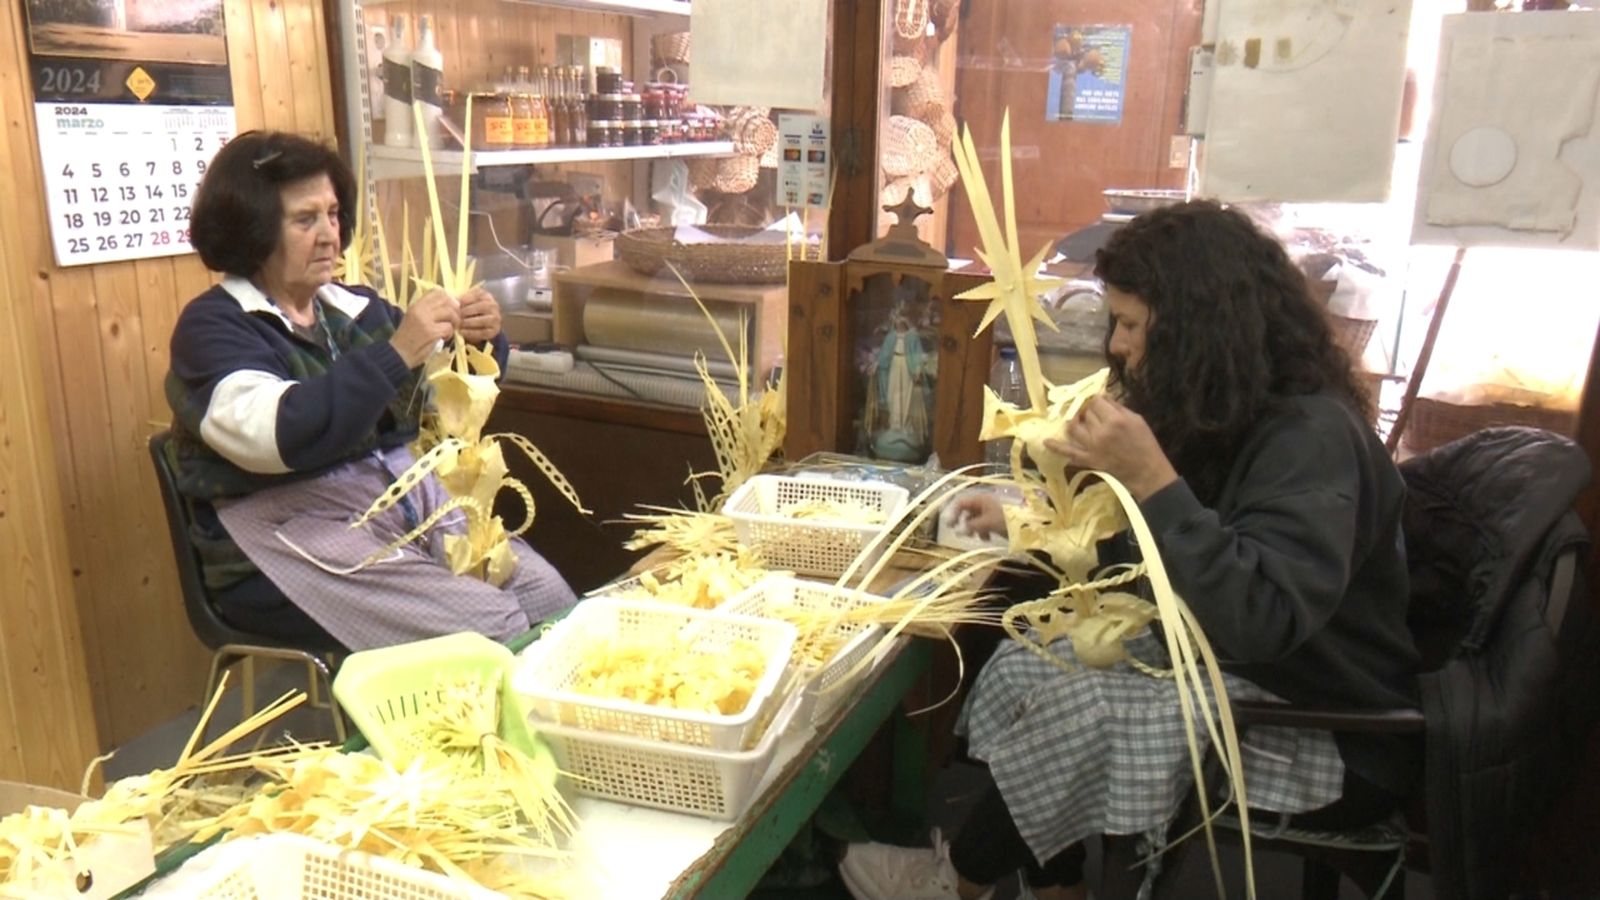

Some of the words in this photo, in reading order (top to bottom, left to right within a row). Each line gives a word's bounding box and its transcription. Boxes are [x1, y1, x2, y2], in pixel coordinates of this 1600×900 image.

[41, 67, 101, 93] 2024
[55, 107, 88, 116] 2024
[57, 118, 104, 128] marzo
[171, 137, 178, 152] 1
[194, 137, 204, 151] 2
[62, 163, 74, 179] 4
[91, 163, 103, 178] 5
[119, 163, 130, 177] 6
[146, 162, 156, 176] 7
[172, 161, 183, 175] 8
[197, 160, 206, 174] 9
[64, 189, 79, 204] 11
[91, 188, 109, 202] 12
[118, 187, 136, 201] 13
[145, 185, 164, 199] 14
[171, 184, 188, 198] 15
[64, 214, 84, 229] 18
[93, 212, 112, 227] 19
[119, 210, 141, 225] 20
[148, 209, 165, 223] 21
[173, 207, 190, 221] 22
[67, 238, 90, 254] 25
[97, 236, 118, 251] 26
[124, 234, 143, 248] 27
[151, 232, 171, 246] 28
[176, 230, 191, 244] 29
